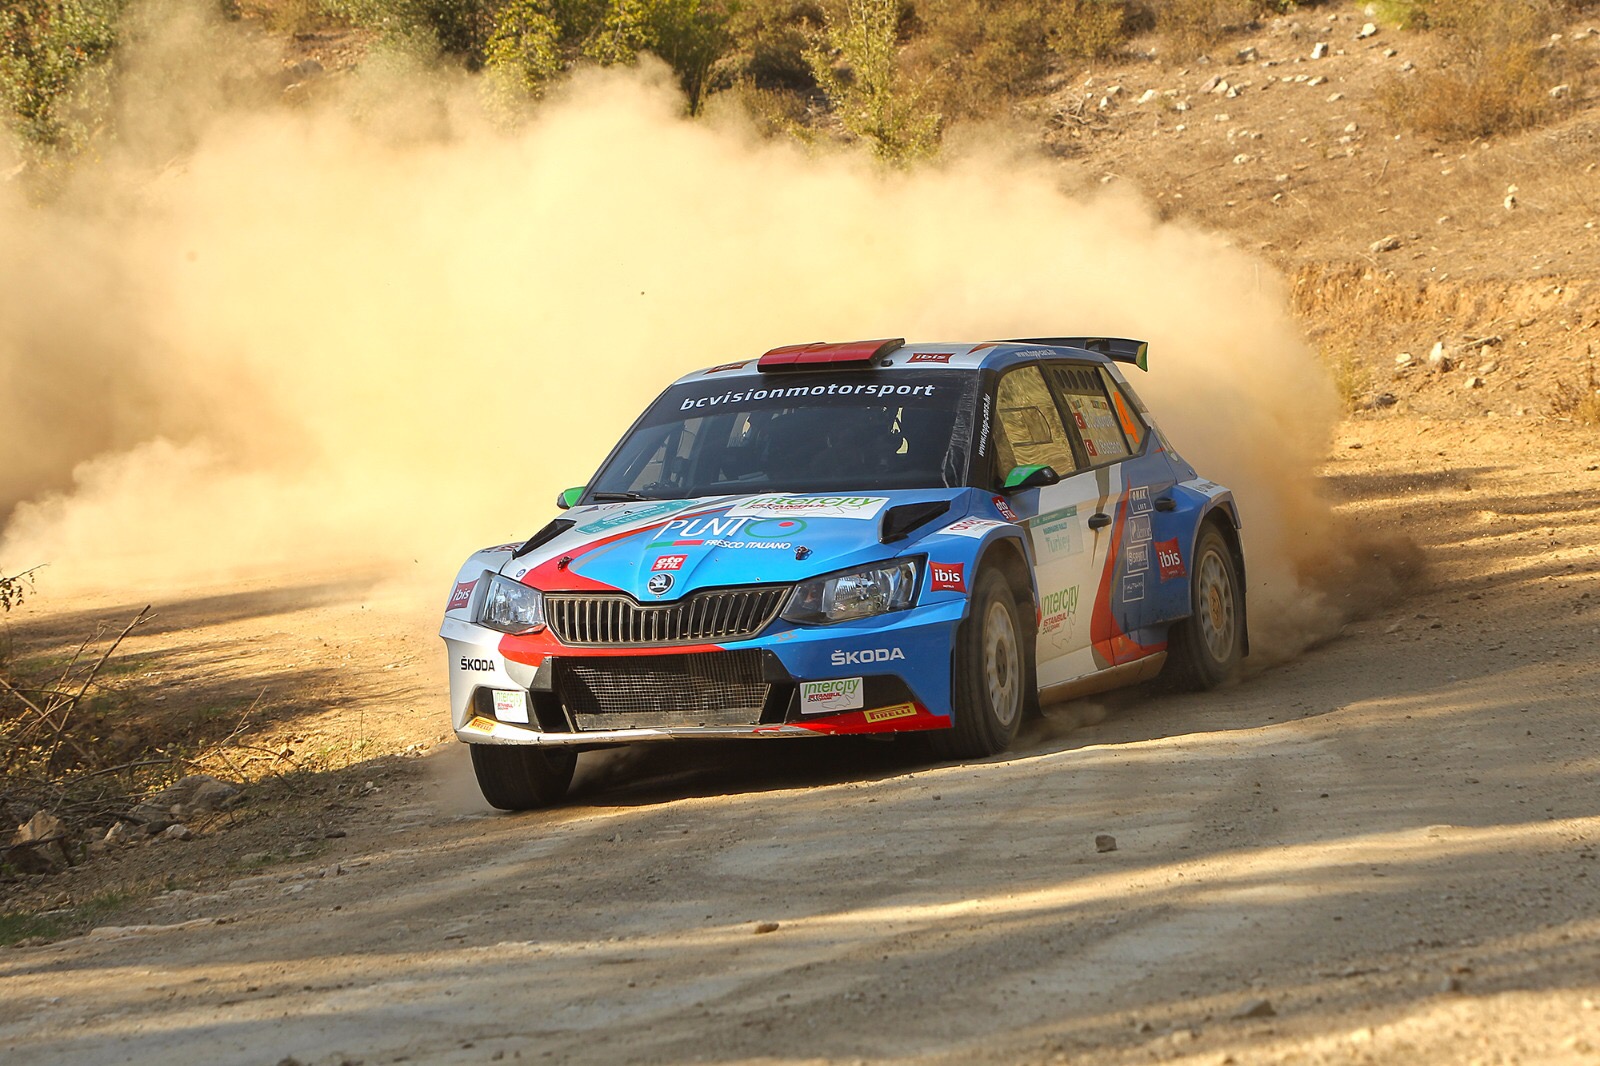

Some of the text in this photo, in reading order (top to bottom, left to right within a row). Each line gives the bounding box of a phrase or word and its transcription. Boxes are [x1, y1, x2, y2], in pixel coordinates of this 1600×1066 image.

[680, 383, 936, 411] bcvisionmotorsport
[1113, 391, 1140, 444] 4
[704, 539, 792, 551] FRESCO ITALIANO
[1159, 549, 1181, 568] ibis
[935, 569, 961, 582] ibis
[452, 588, 471, 602] ibis
[460, 656, 495, 671] ŠKODA
[831, 648, 905, 665] ŠKODA
[869, 705, 912, 721] PIRELLI
[472, 719, 495, 731] PIRELLI
